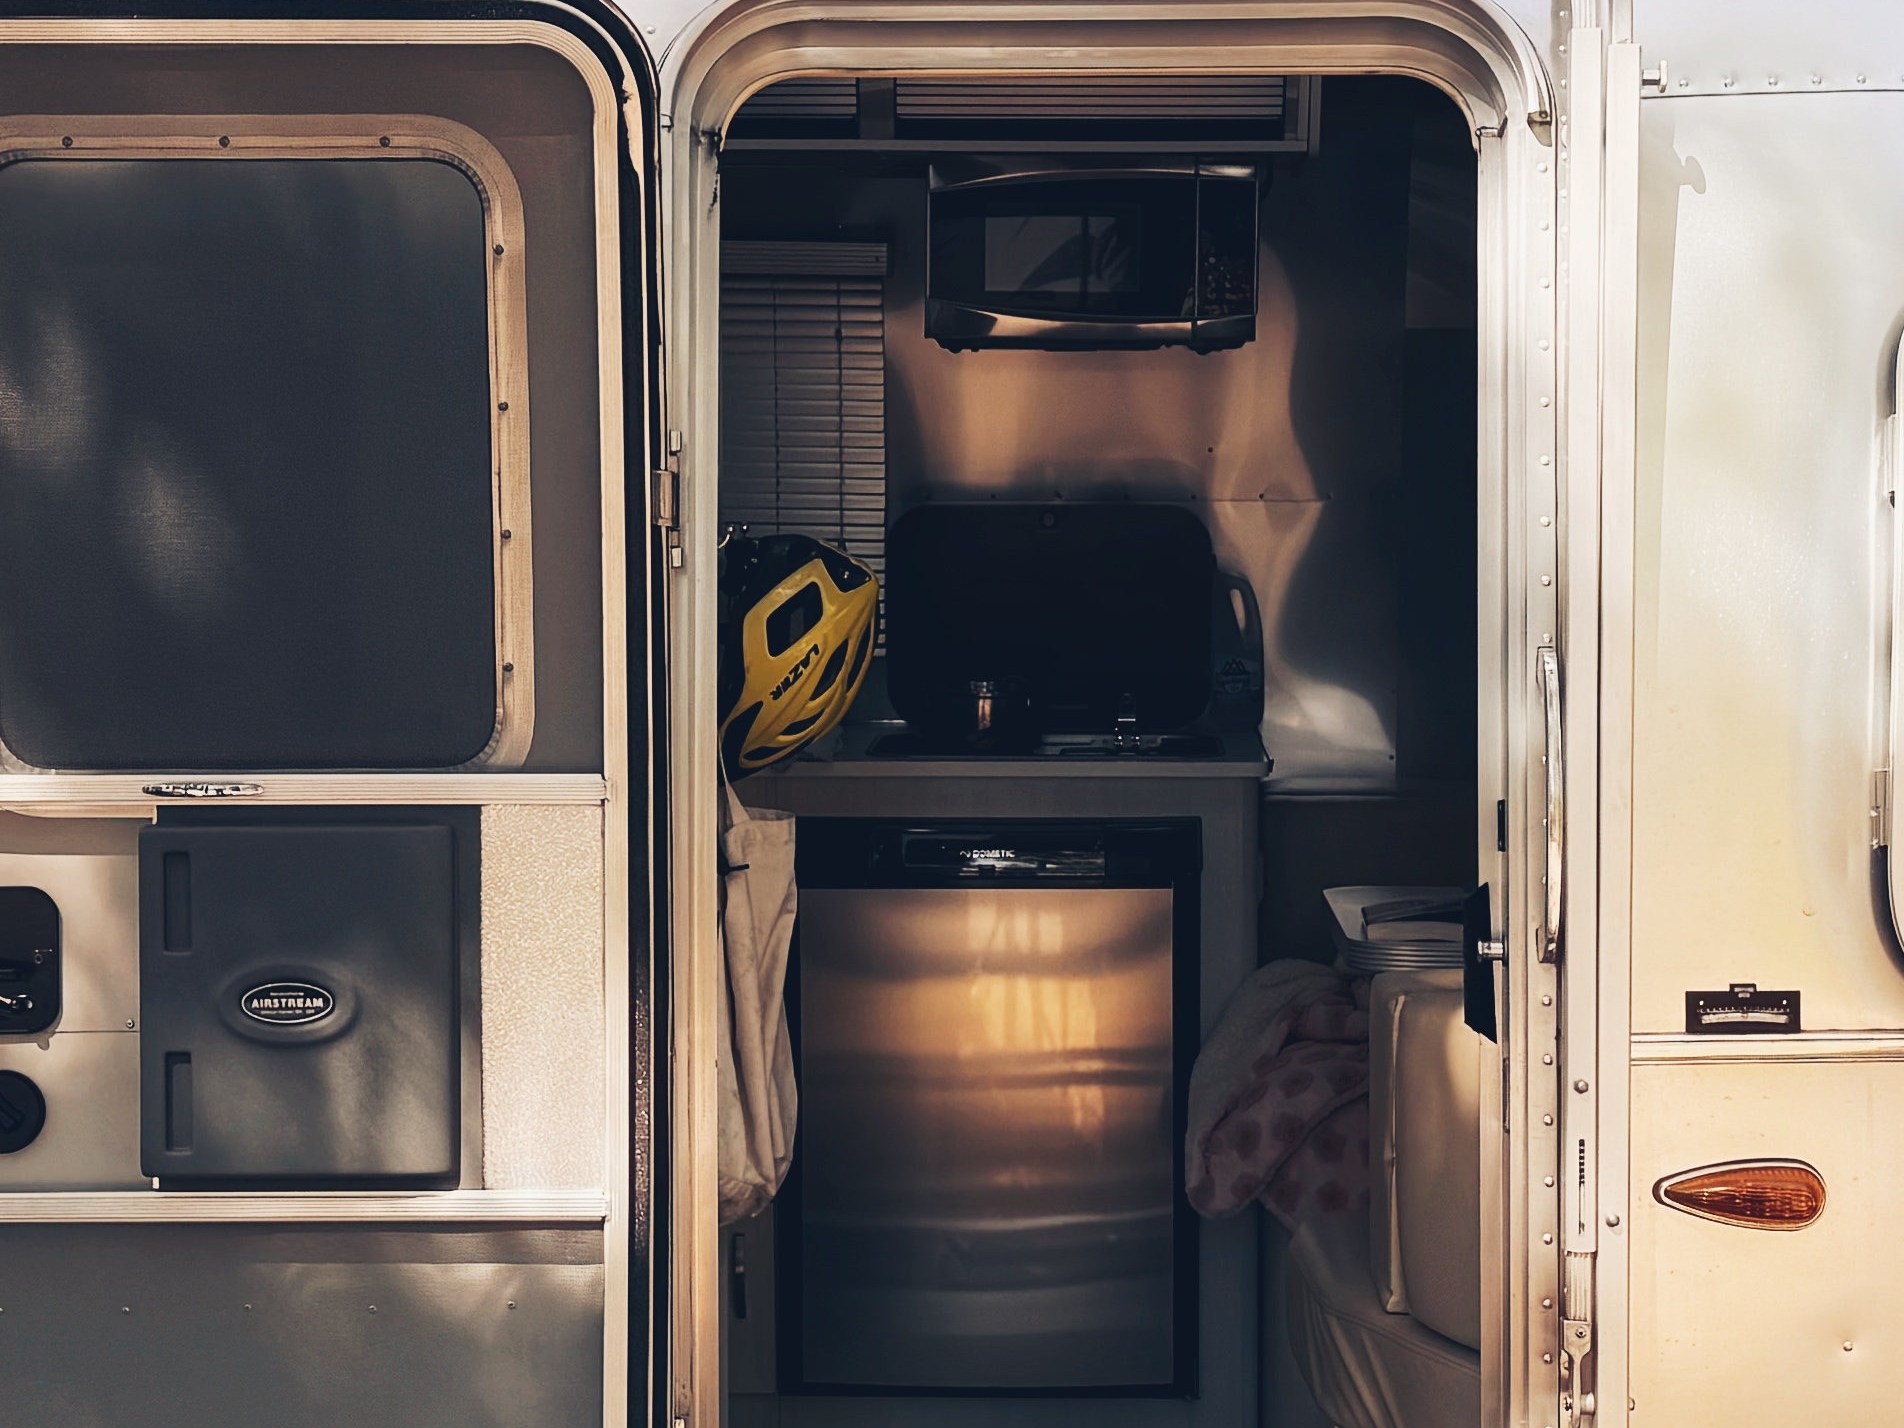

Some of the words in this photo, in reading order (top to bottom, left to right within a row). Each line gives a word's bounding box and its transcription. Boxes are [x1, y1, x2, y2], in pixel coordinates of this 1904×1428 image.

[769, 643, 820, 701] LAZER
[972, 849, 1016, 859] DOMETIC
[251, 997, 324, 1009] AIRSTREAM
